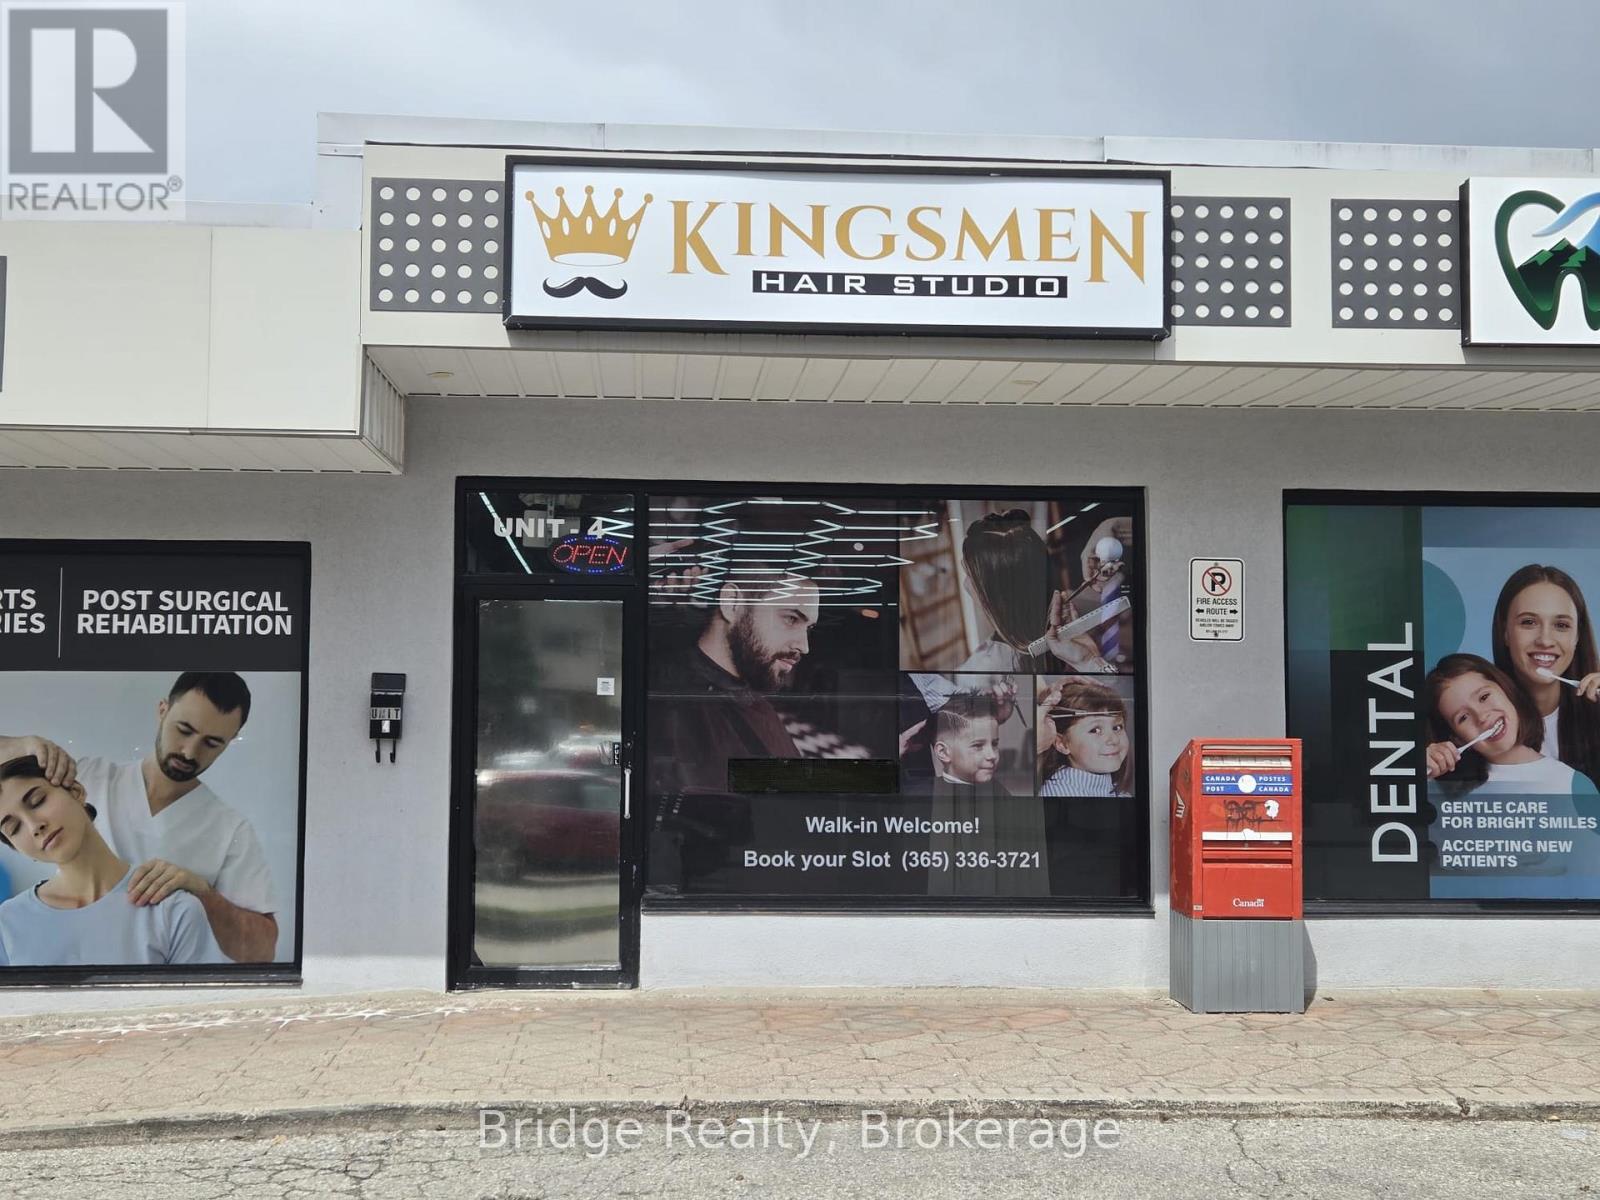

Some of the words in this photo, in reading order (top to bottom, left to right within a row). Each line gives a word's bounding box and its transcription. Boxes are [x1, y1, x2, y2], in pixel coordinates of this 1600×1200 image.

[666, 199, 1151, 285] KINGSMEN
[759, 272, 867, 294] HAIR
[892, 275, 1061, 297] STUDIO
[493, 517, 566, 539] UNIT
[552, 543, 628, 565] OPEN
[0, 588, 37, 610] TS
[82, 589, 153, 611] POST
[158, 590, 289, 612] SURGICAL
[1196, 597, 1211, 605] FIRE
[1212, 597, 1238, 606] ACCESS
[1206, 607, 1229, 616] ROUTE
[0, 612, 46, 634] IES
[76, 613, 293, 636] REHABILITATION
[1367, 622, 1419, 863] DENTAL
[1441, 801, 1503, 814] GENTLE
[1505, 801, 1548, 814] CARE
[805, 816, 878, 834] Walk-in
[883, 816, 980, 834] Welcome!
[1441, 816, 1473, 829] FOR
[1477, 816, 1536, 829] BRIGHT
[1539, 816, 1597, 829] SMILES
[1442, 839, 1533, 853] ACCEPTING
[1536, 840, 1574, 853] NEW
[744, 850, 796, 868] Book
[801, 854, 847, 871] your
[851, 850, 891, 868] Slot
[901, 851, 950, 872] (365)
[955, 851, 1041, 869] 336-3721
[1442, 855, 1518, 868] PATIENTS
[1232, 897, 1265, 908] Canada
